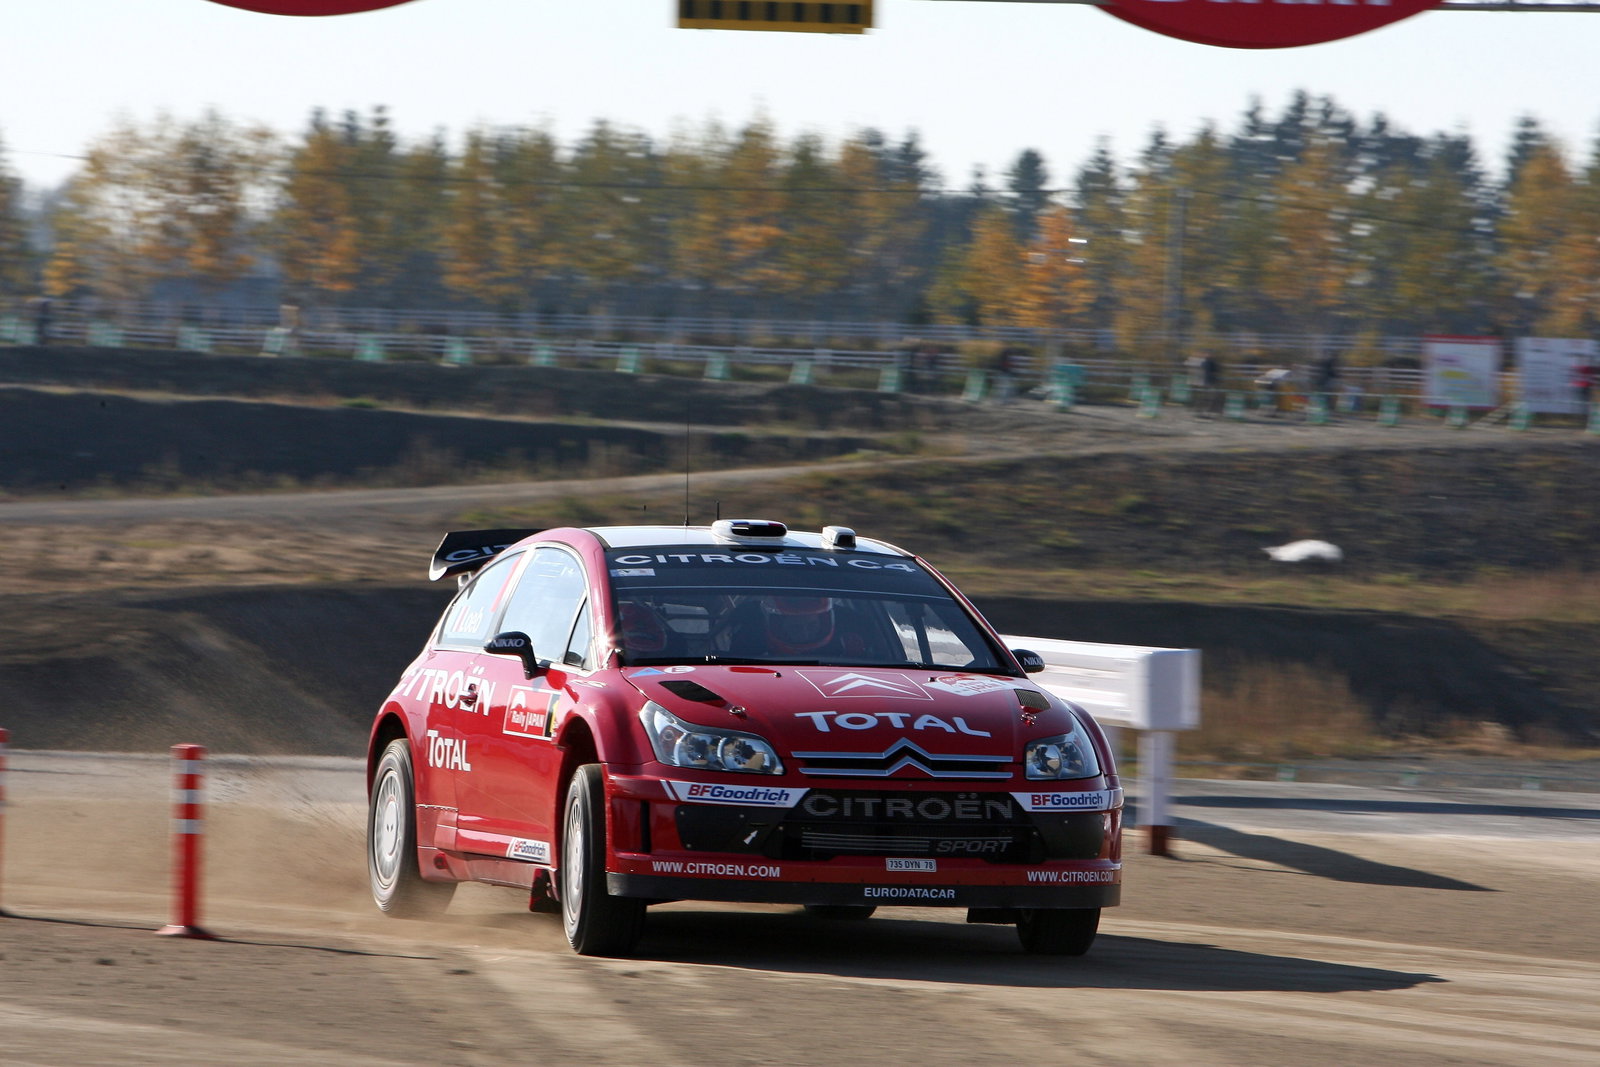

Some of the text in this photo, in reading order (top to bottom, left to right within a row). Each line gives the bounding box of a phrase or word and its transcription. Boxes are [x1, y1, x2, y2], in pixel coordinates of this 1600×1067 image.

[614, 553, 916, 573] CITROËN C4
[391, 666, 497, 717] CITROËN
[511, 710, 526, 727] Rally
[524, 712, 546, 732] JAPAN
[794, 710, 992, 738] TOTAL
[427, 729, 472, 772] TOTAL
[687, 784, 790, 802] BFGoodrich
[1031, 792, 1103, 806] BFGoodrich
[803, 793, 1013, 820] CITROËN
[936, 840, 1013, 853] SPORT
[652, 861, 781, 878] WWW.CITROEN.COM
[889, 860, 934, 870] 735 DYN 78
[1027, 870, 1114, 883] WWW.CITROEN.COM
[863, 887, 956, 899] EURODATACAR
